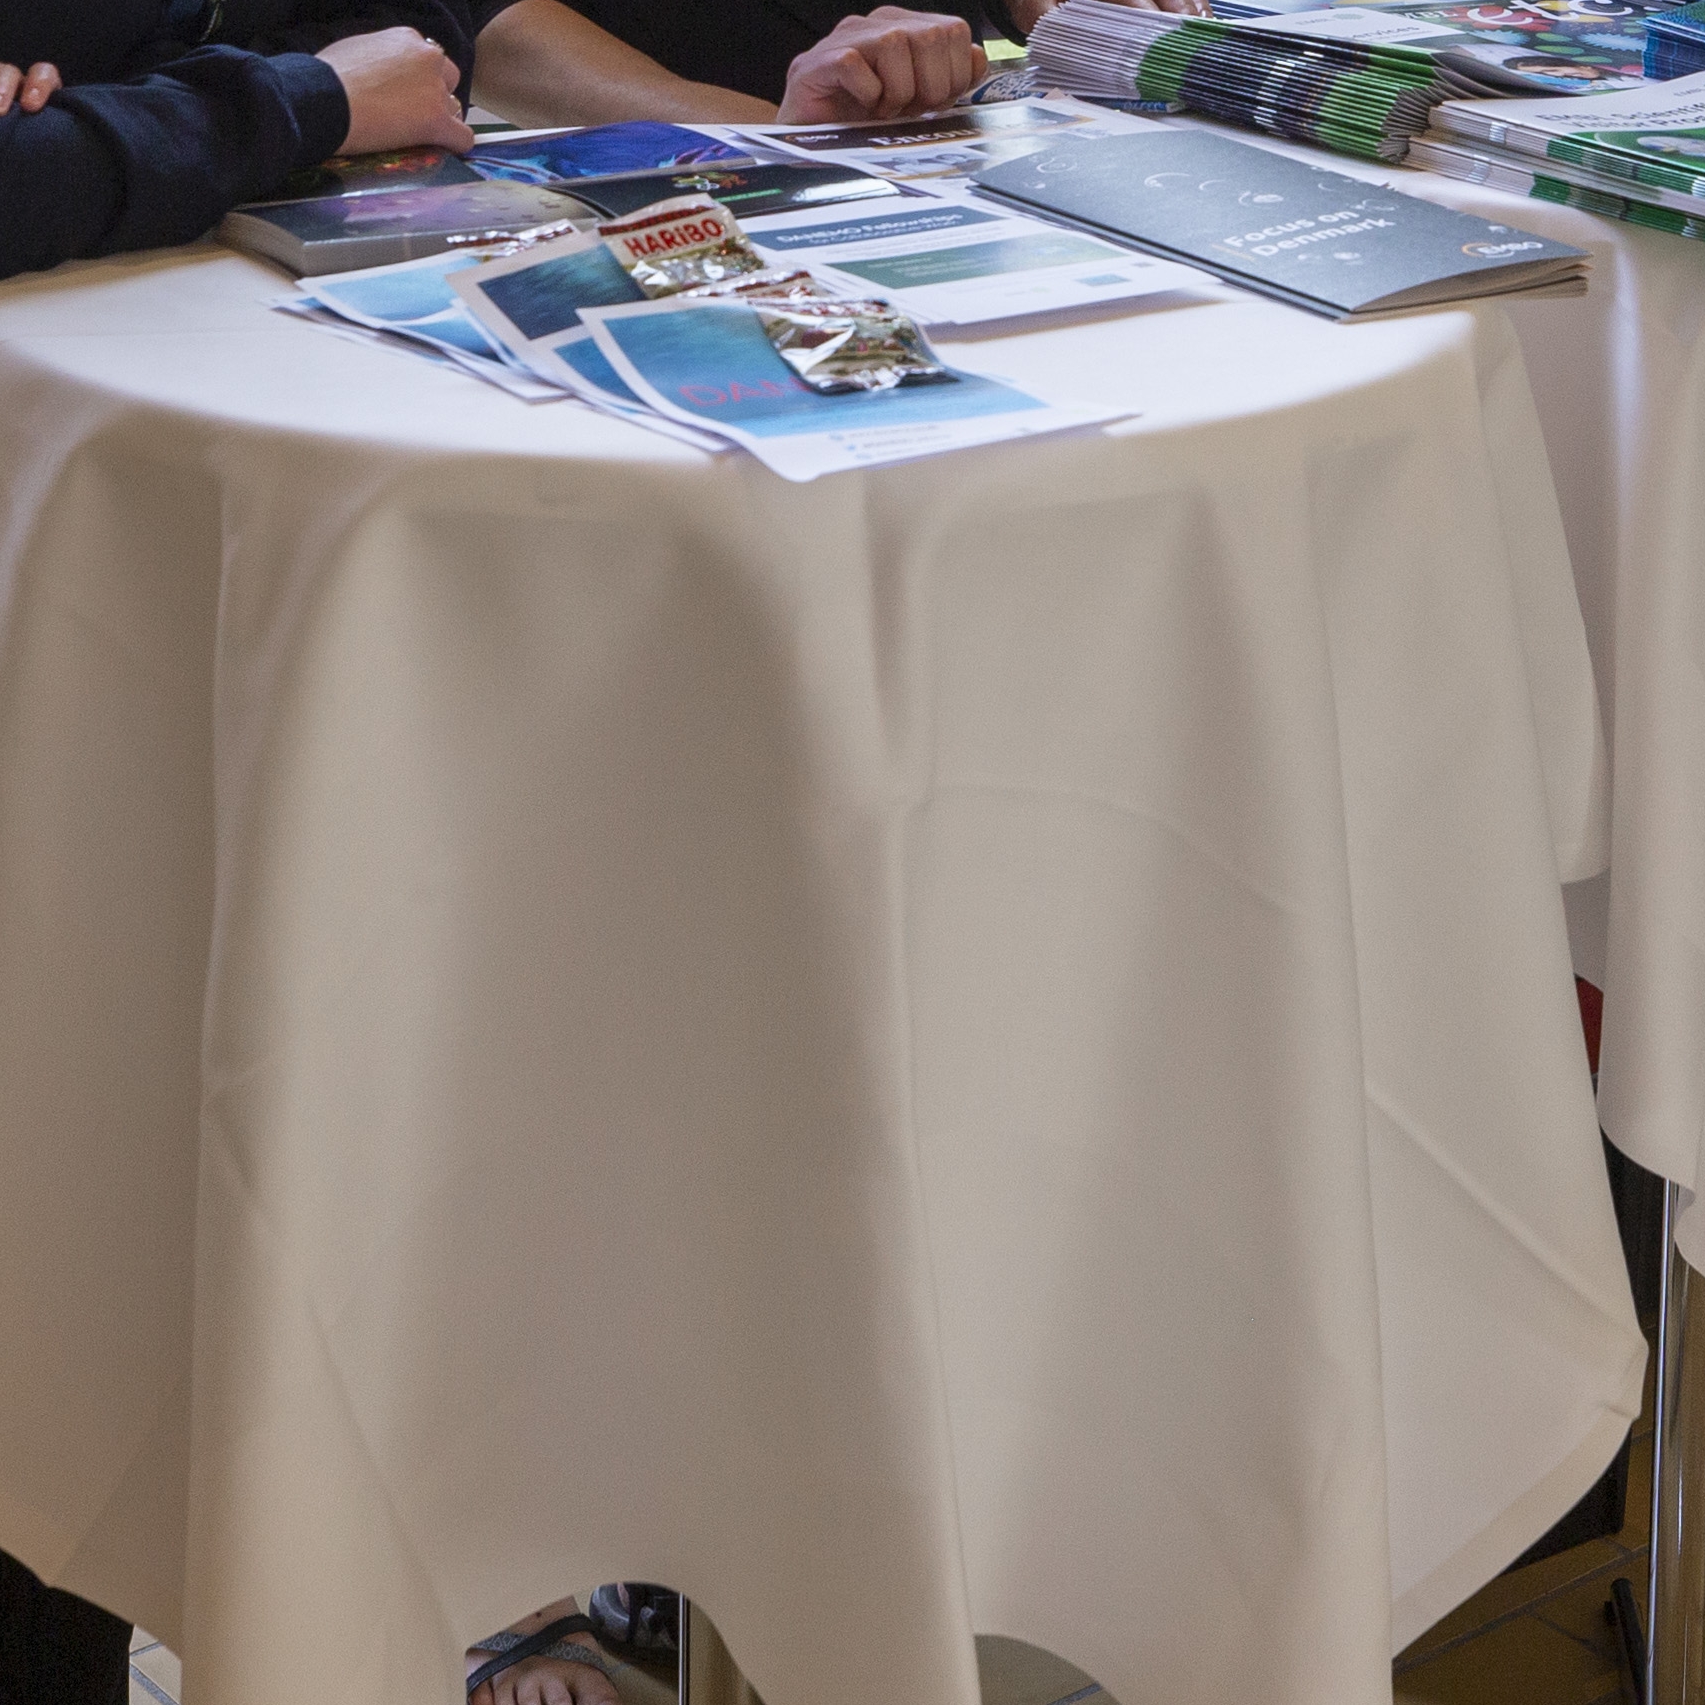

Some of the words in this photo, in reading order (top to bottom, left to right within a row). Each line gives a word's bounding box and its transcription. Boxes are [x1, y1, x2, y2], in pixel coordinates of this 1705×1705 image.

[1223, 217, 1317, 248] Focus
[1318, 208, 1361, 224] on
[1249, 216, 1397, 259] Denmark
[1475, 240, 1545, 257] EMBO
